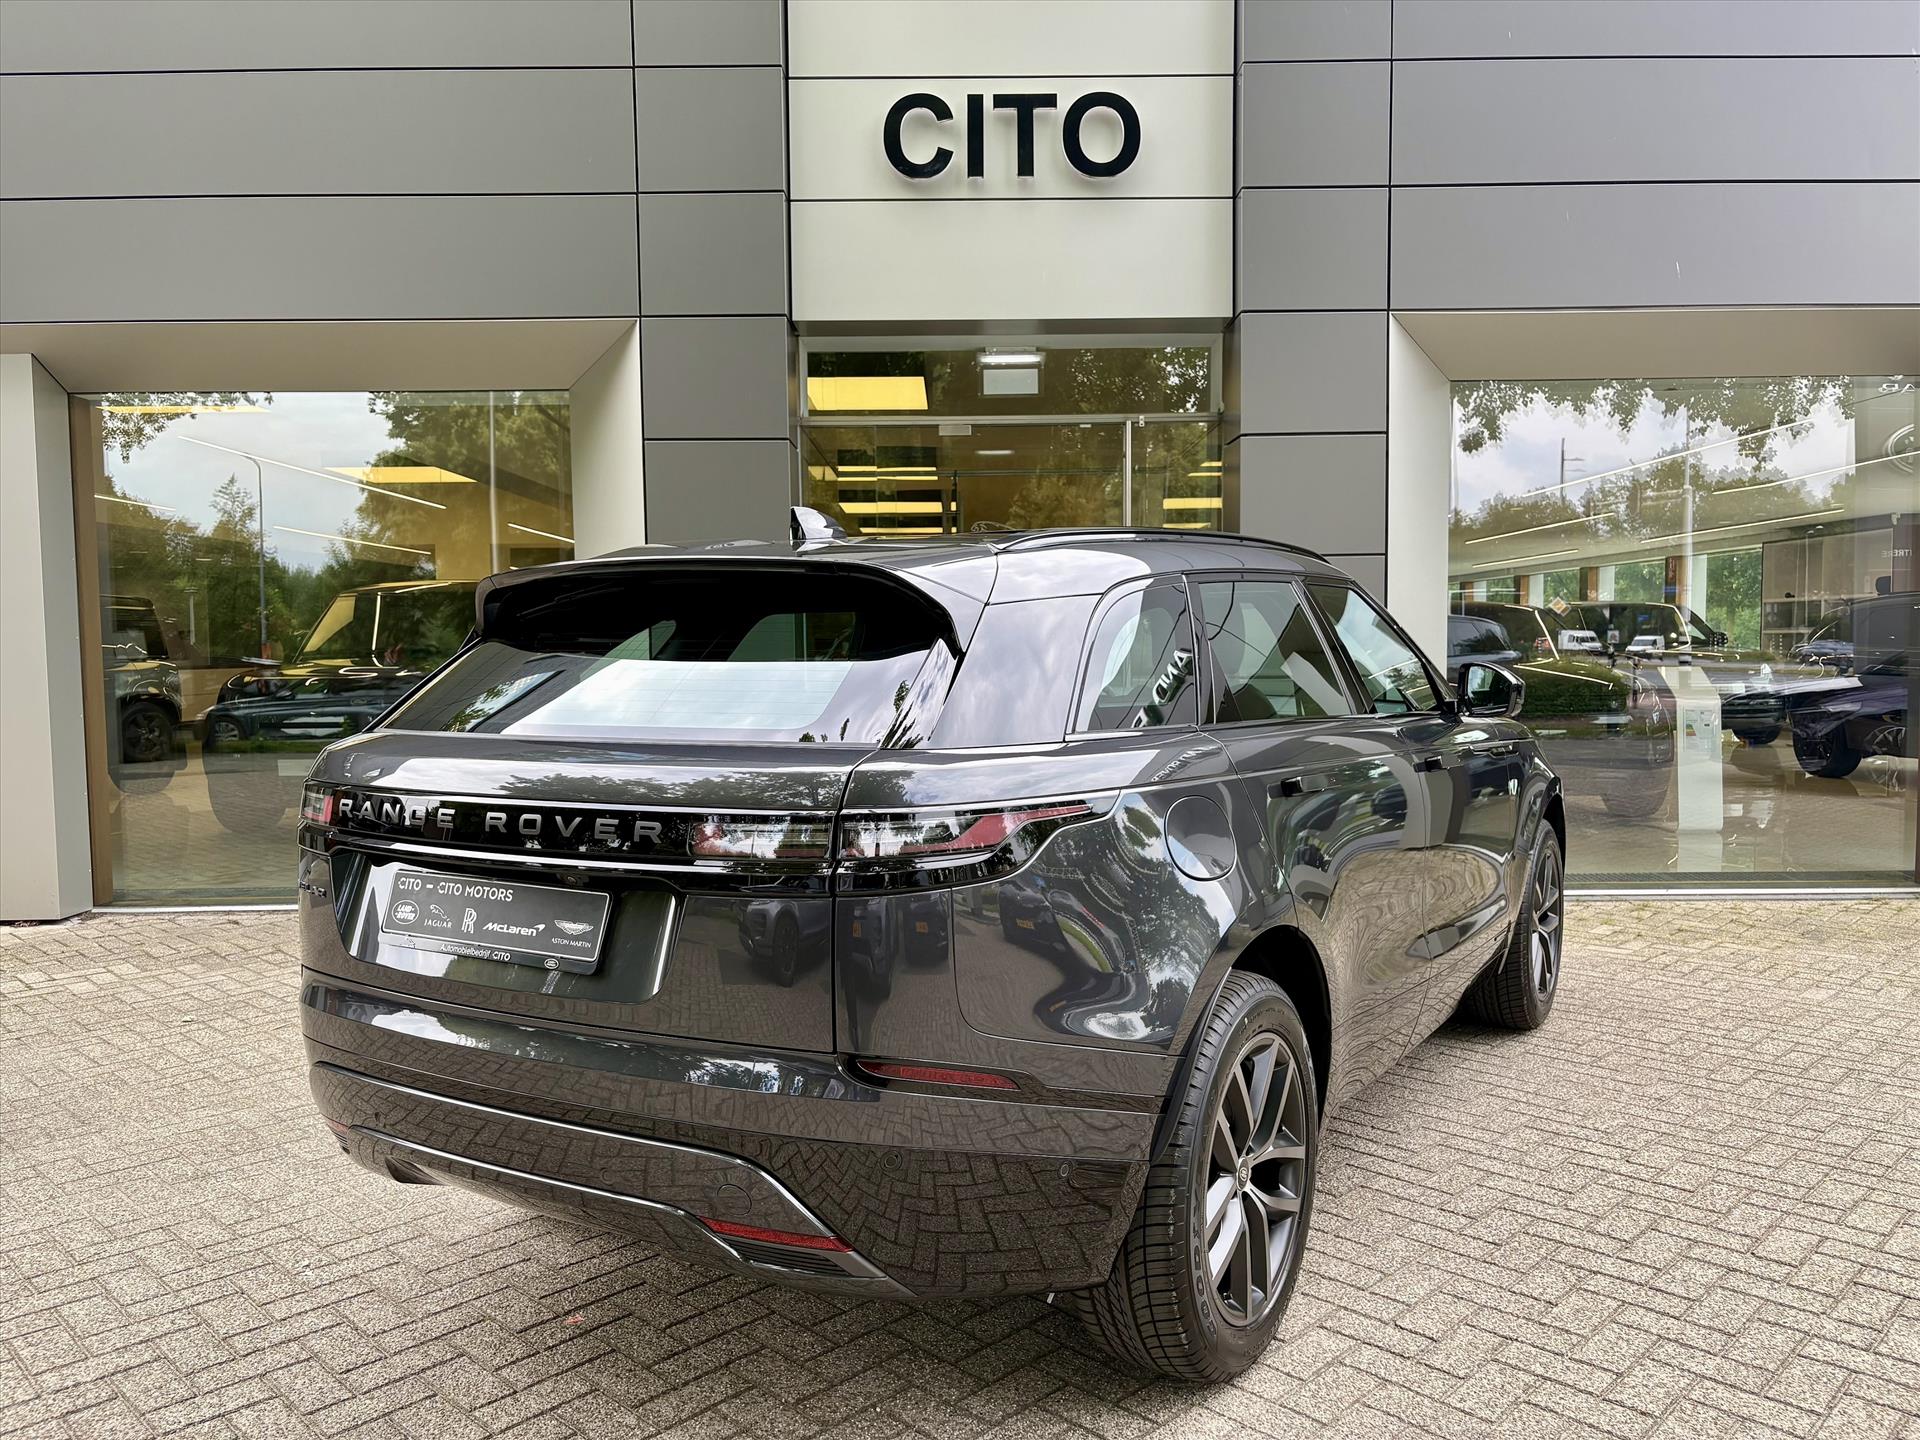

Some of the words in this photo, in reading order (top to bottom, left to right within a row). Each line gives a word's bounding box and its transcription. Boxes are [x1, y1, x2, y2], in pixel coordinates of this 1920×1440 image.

[883, 91, 1141, 178] CITO
[339, 798, 455, 829] RANGE
[485, 811, 662, 844] ROVER
[398, 877, 422, 890] CITO
[437, 881, 462, 895] CITO
[465, 885, 514, 902] MOTORS
[424, 918, 452, 929] JAGUAR
[440, 943, 490, 959] Automobielbedrijf
[492, 950, 511, 961] CITO
[551, 937, 569, 945] ASTON
[570, 939, 592, 948] MARTIN
